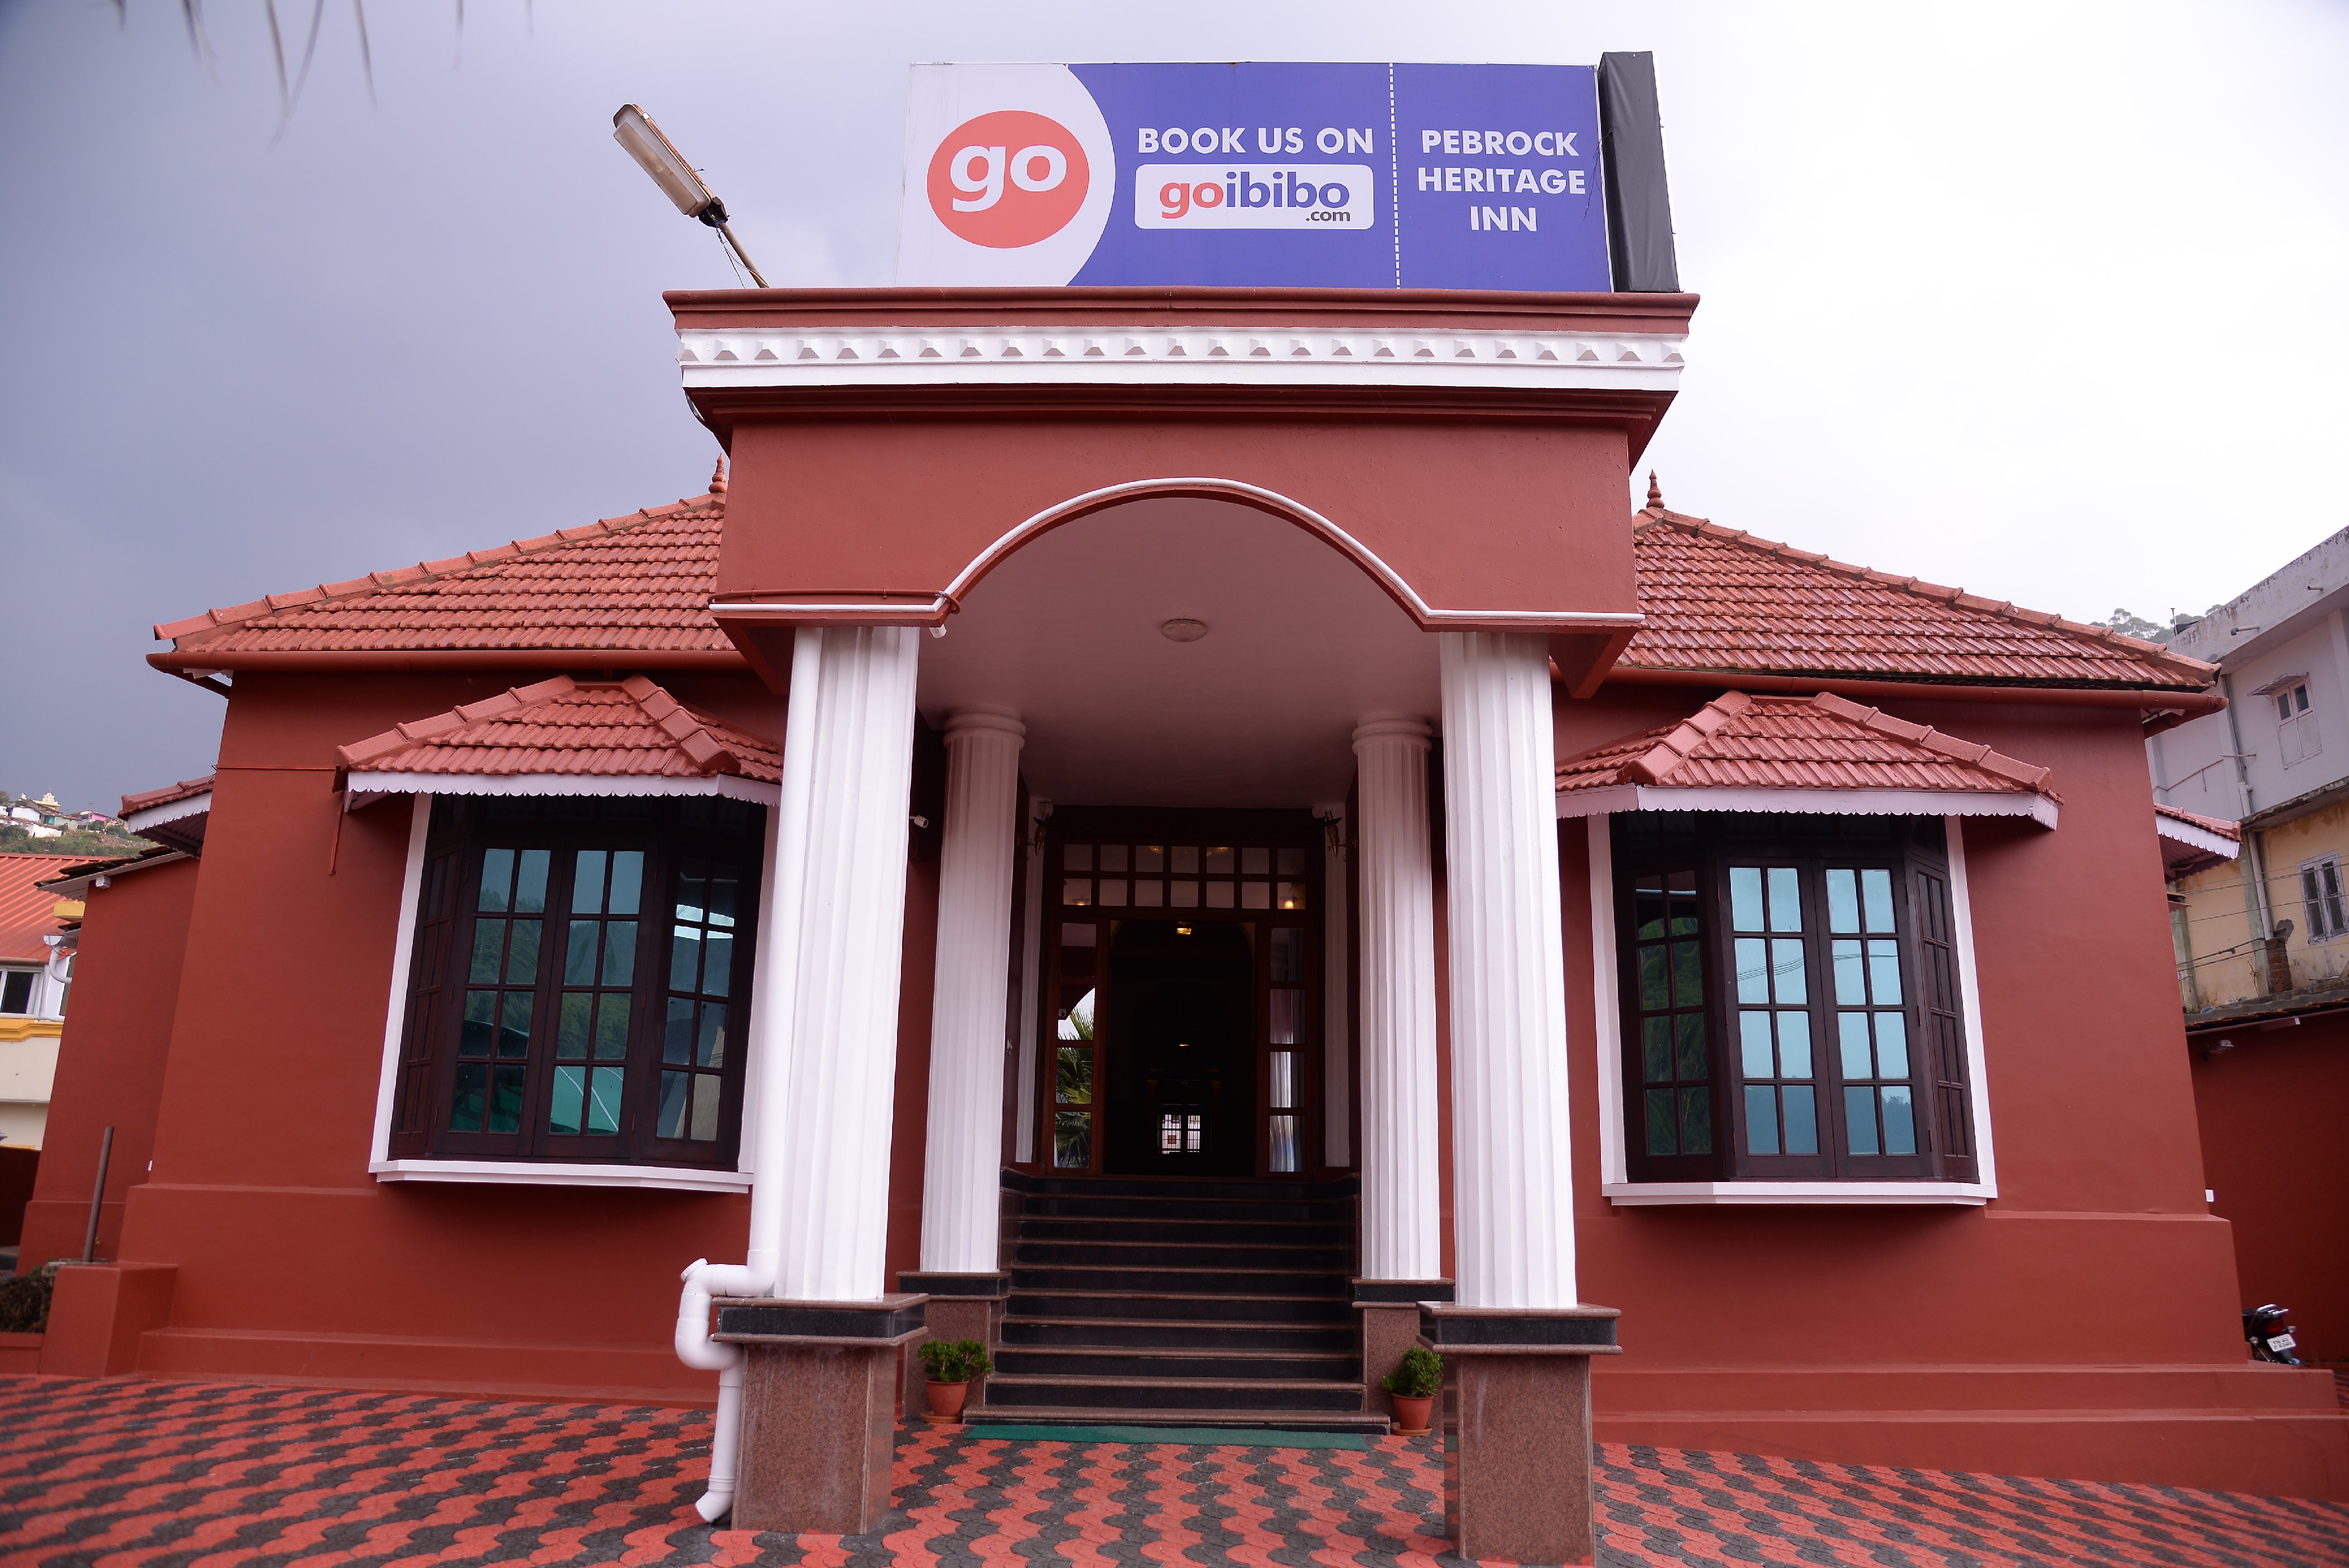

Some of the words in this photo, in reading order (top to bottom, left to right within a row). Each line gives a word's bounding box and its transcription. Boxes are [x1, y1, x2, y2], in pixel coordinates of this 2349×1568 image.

[1138, 127, 1246, 154] BOOK
[1258, 127, 1304, 154] US
[1315, 127, 1373, 154] ON
[1421, 129, 1579, 157] PEBROCK
[949, 145, 1067, 212] go
[1417, 167, 1586, 195] HERITAGE
[1159, 171, 1350, 219] goibibo
[1305, 211, 1350, 222] .com
[1470, 206, 1537, 232] INN
